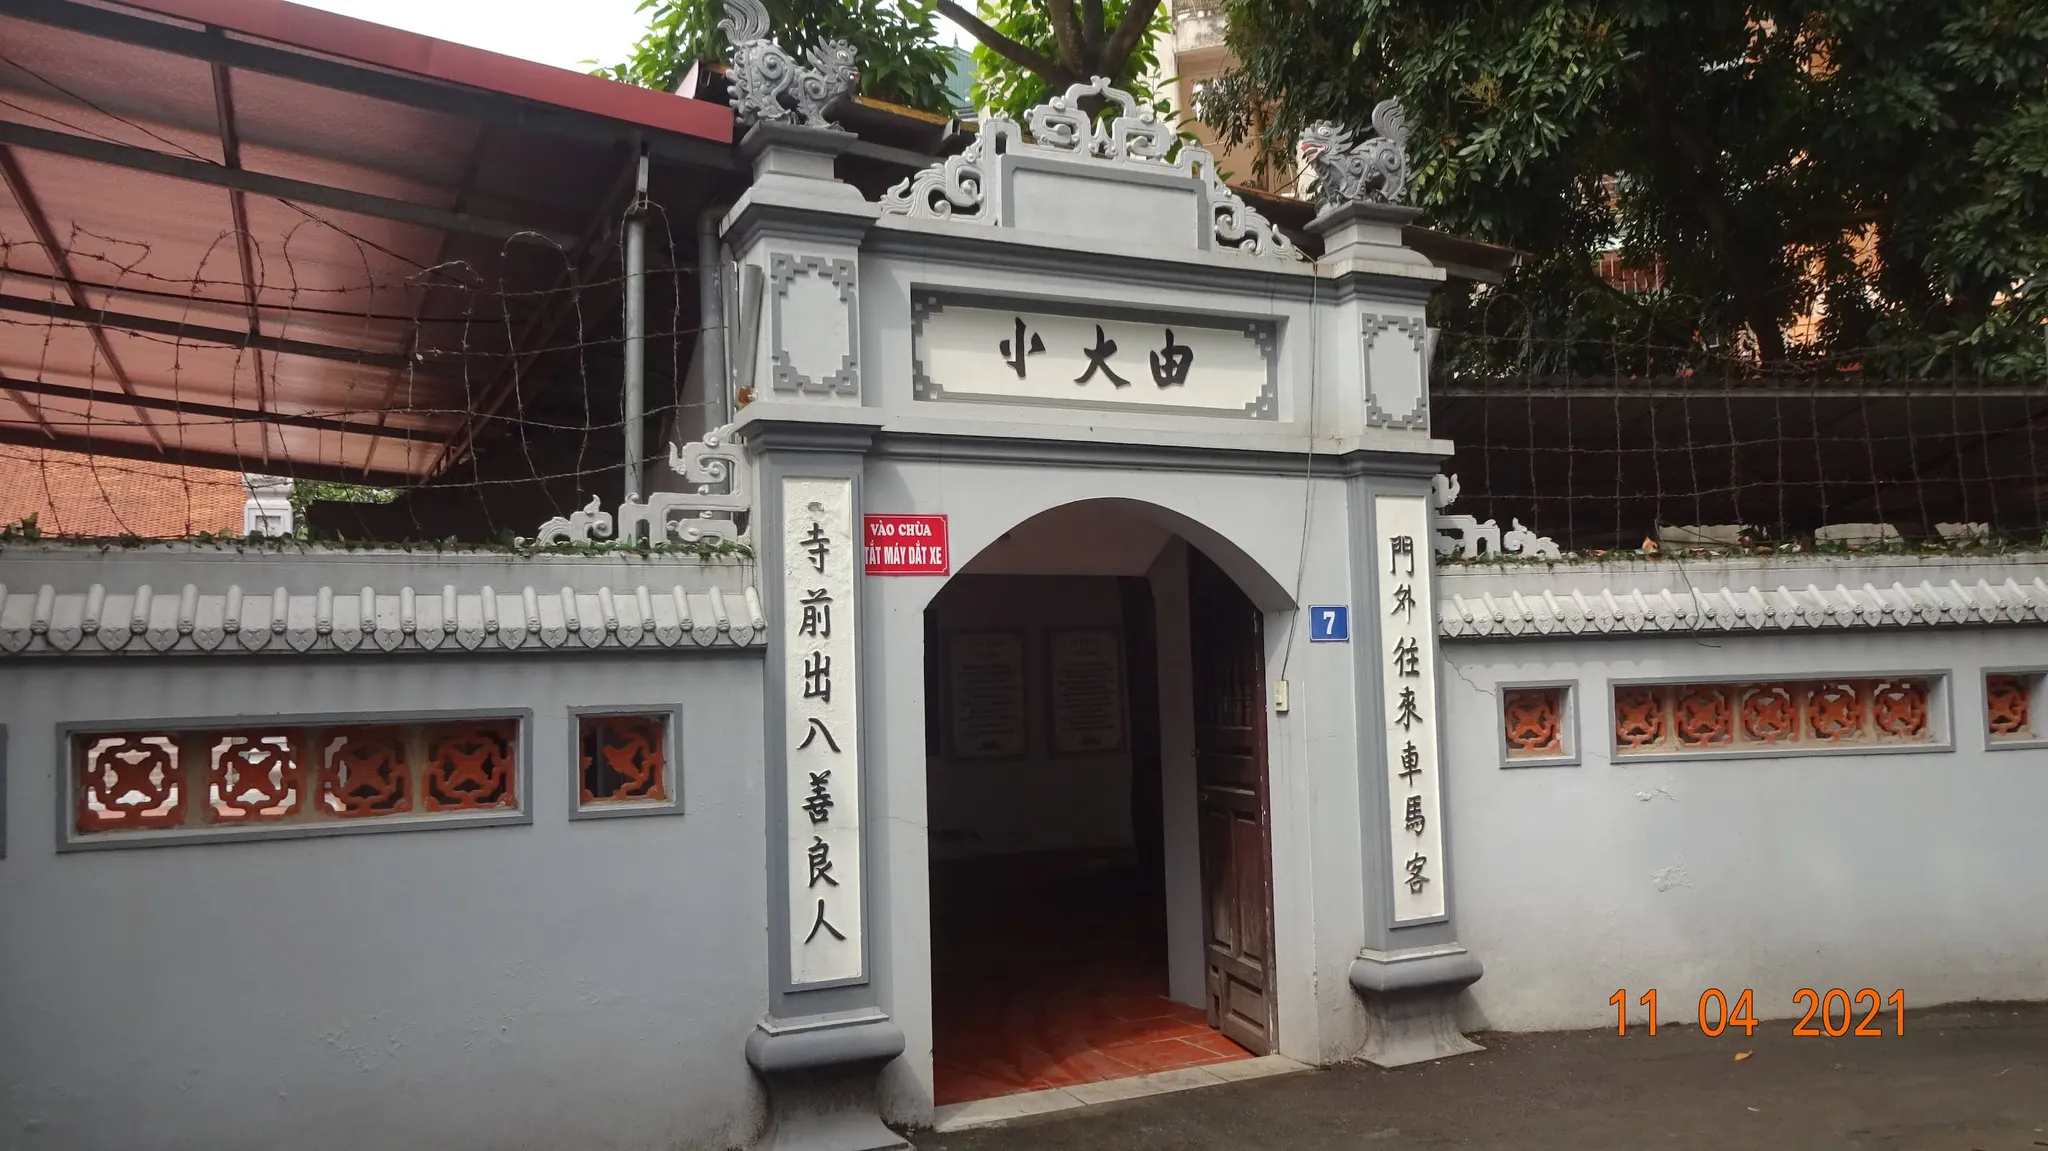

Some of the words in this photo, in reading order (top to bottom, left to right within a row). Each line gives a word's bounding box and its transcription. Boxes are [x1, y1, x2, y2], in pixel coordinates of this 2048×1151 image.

[870, 520, 895, 536] VÀO
[898, 521, 932, 536] CHÙA
[884, 542, 906, 565] MÁY
[909, 540, 927, 565] DẮT
[930, 546, 942, 565] XE
[1323, 611, 1335, 635] 7
